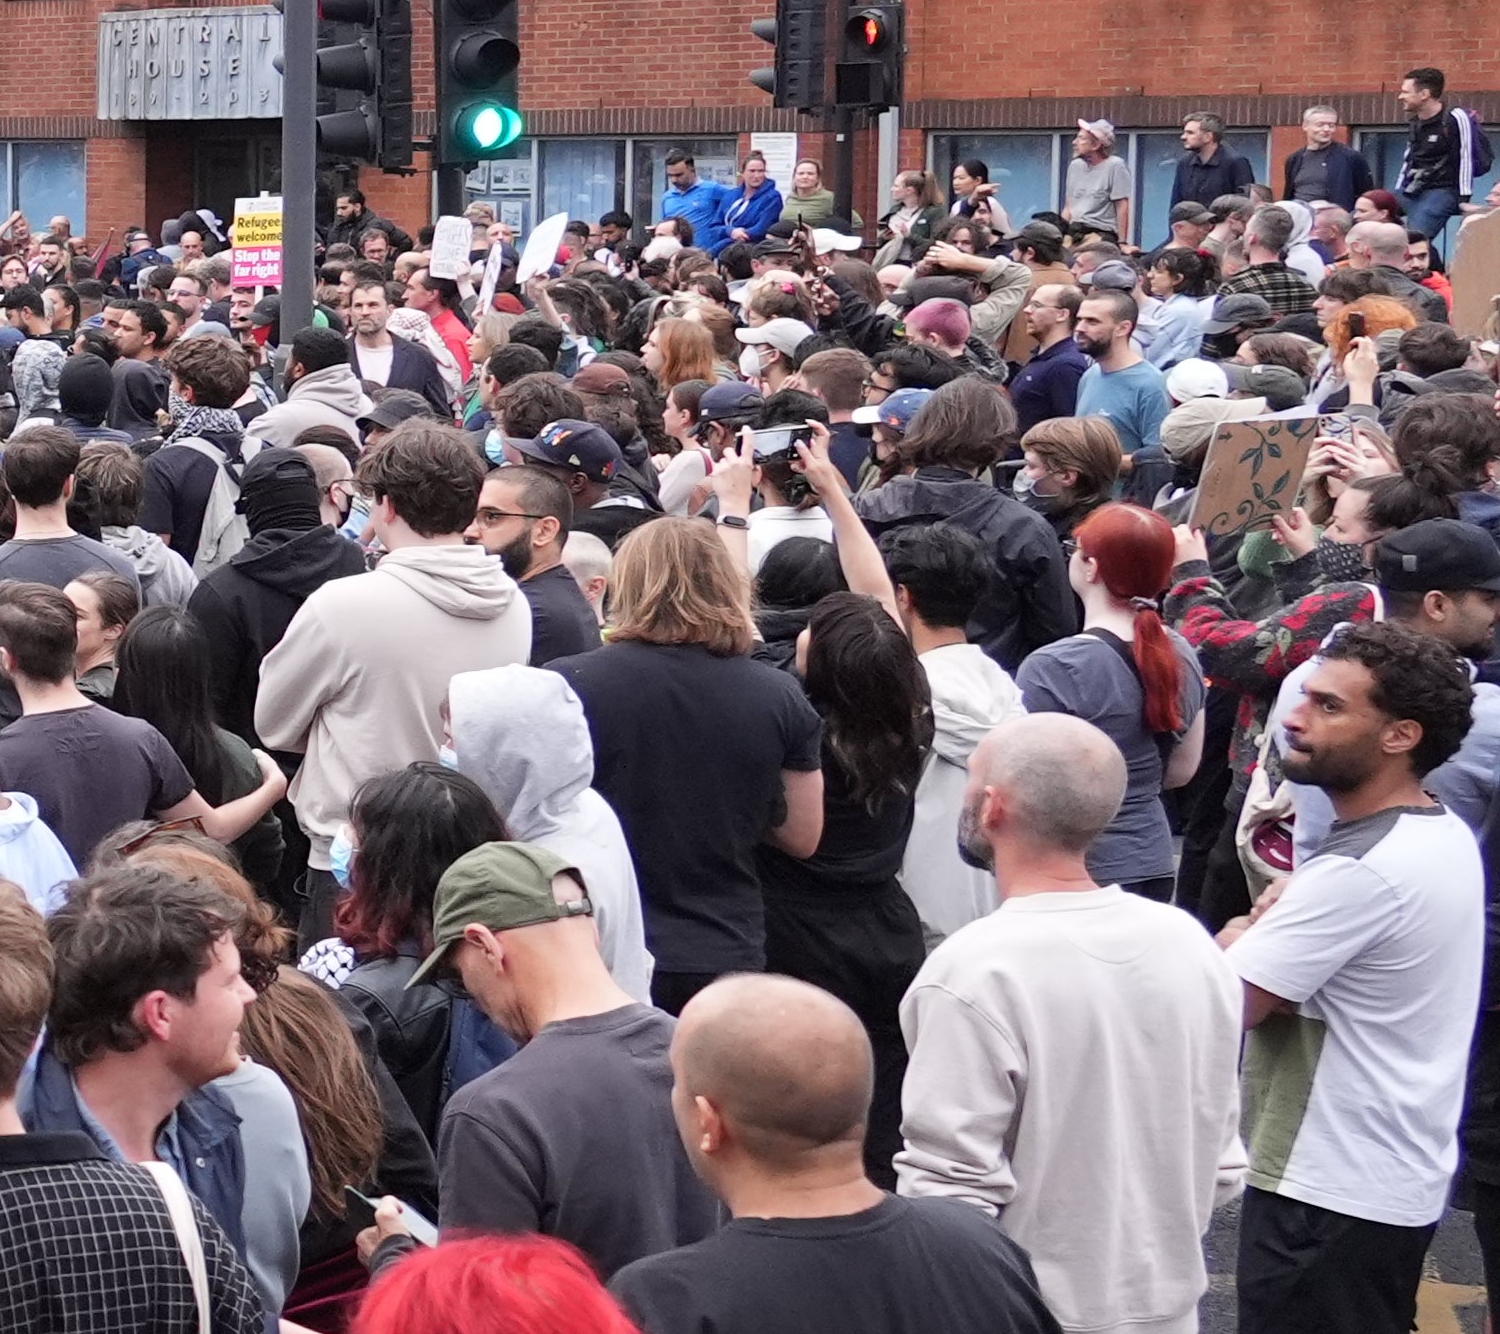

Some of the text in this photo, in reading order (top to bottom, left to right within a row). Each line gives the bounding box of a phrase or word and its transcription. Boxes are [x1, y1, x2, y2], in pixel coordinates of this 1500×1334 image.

[112, 20, 271, 47] CENTRAL
[127, 55, 240, 80] HOUSE
[237, 216, 280, 230] Refugee
[237, 231, 282, 242] welcome
[235, 248, 280, 265] Stop the
[234, 263, 279, 279] far right
